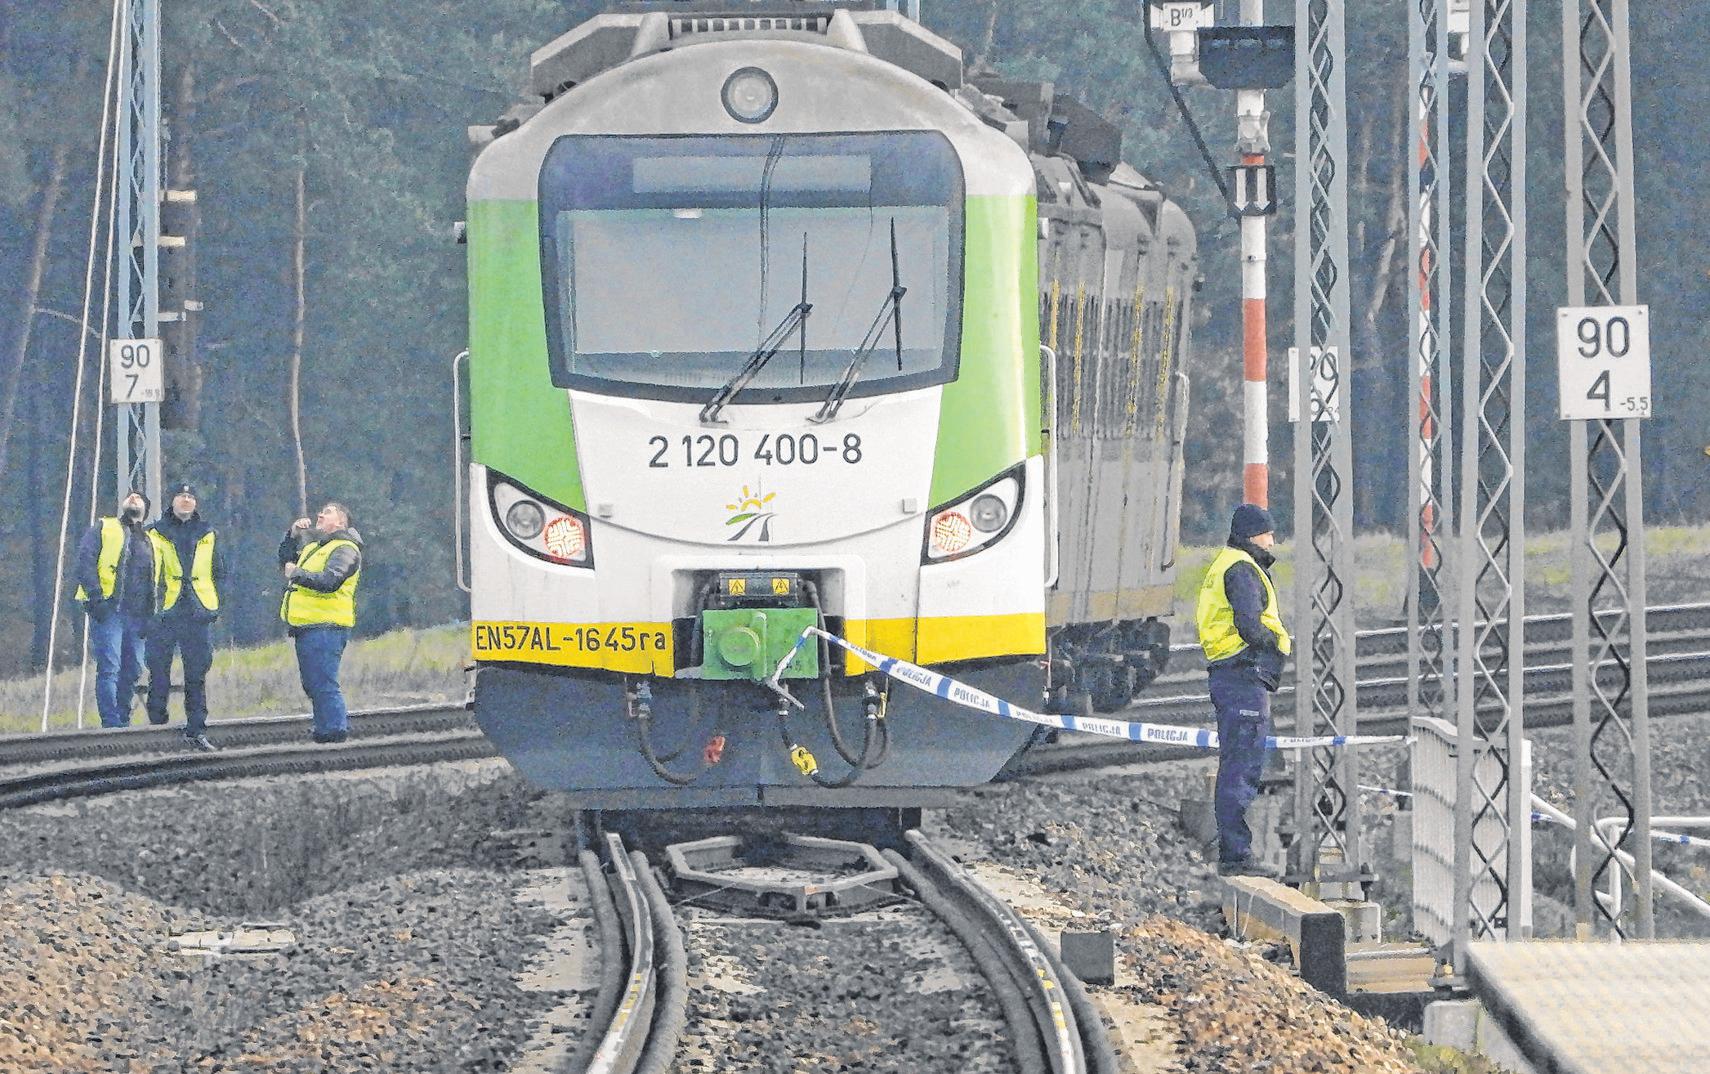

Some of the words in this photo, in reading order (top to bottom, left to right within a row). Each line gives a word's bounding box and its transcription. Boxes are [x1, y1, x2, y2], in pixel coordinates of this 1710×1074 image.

[1577, 316, 1630, 359] 90
[121, 344, 150, 368] 90
[125, 373, 139, 399] 7
[1586, 369, 1610, 412] 4
[1620, 396, 1648, 411] -5.5
[649, 435, 669, 468] 2
[682, 434, 739, 467] 120
[754, 433, 862, 466] 400-8
[476, 625, 666, 652] EN57AL-1645ra
[1147, 727, 1189, 742] POLICJA
